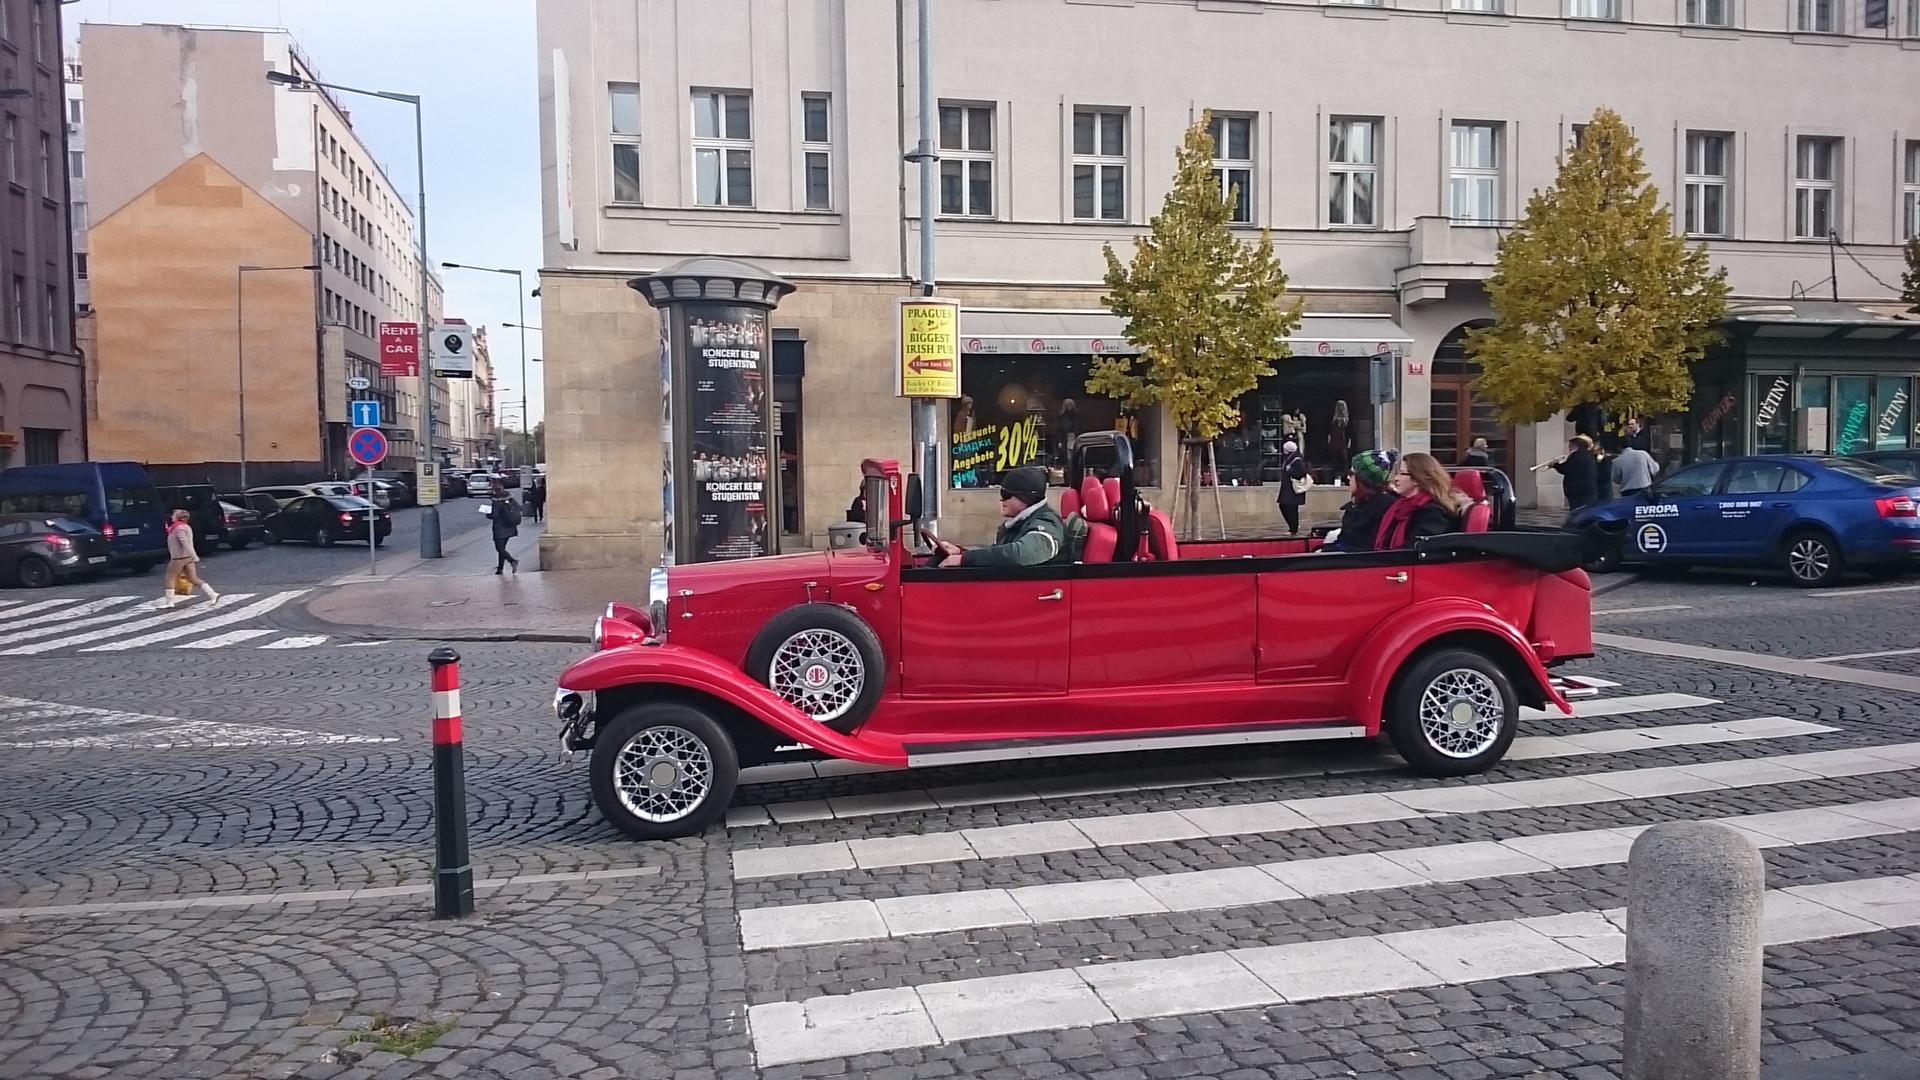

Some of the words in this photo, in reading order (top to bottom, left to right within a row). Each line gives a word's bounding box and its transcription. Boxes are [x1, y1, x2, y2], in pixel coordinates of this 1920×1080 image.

[908, 308, 952, 318] PRAGUES
[381, 327, 416, 336] RENT
[910, 333, 950, 343] BIGGEST
[385, 345, 414, 353] CAR
[702, 349, 740, 358] KONCERT
[906, 344, 934, 354] IRISH
[937, 345, 954, 354] PUB
[708, 359, 757, 369] STUDENTSTVA
[1756, 376, 1789, 427] KVĚTINY
[1701, 391, 1735, 434] FLOWERS
[1876, 388, 1909, 439] KVĚTINY
[1836, 400, 1868, 455] FLOWERS
[953, 425, 996, 444] Discounts
[996, 414, 1038, 472] 30%
[953, 450, 994, 471] Angebote
[706, 482, 743, 492] KONCERT
[712, 492, 760, 502] STUDENTSTVA
[1635, 504, 1679, 514] EVROPA
